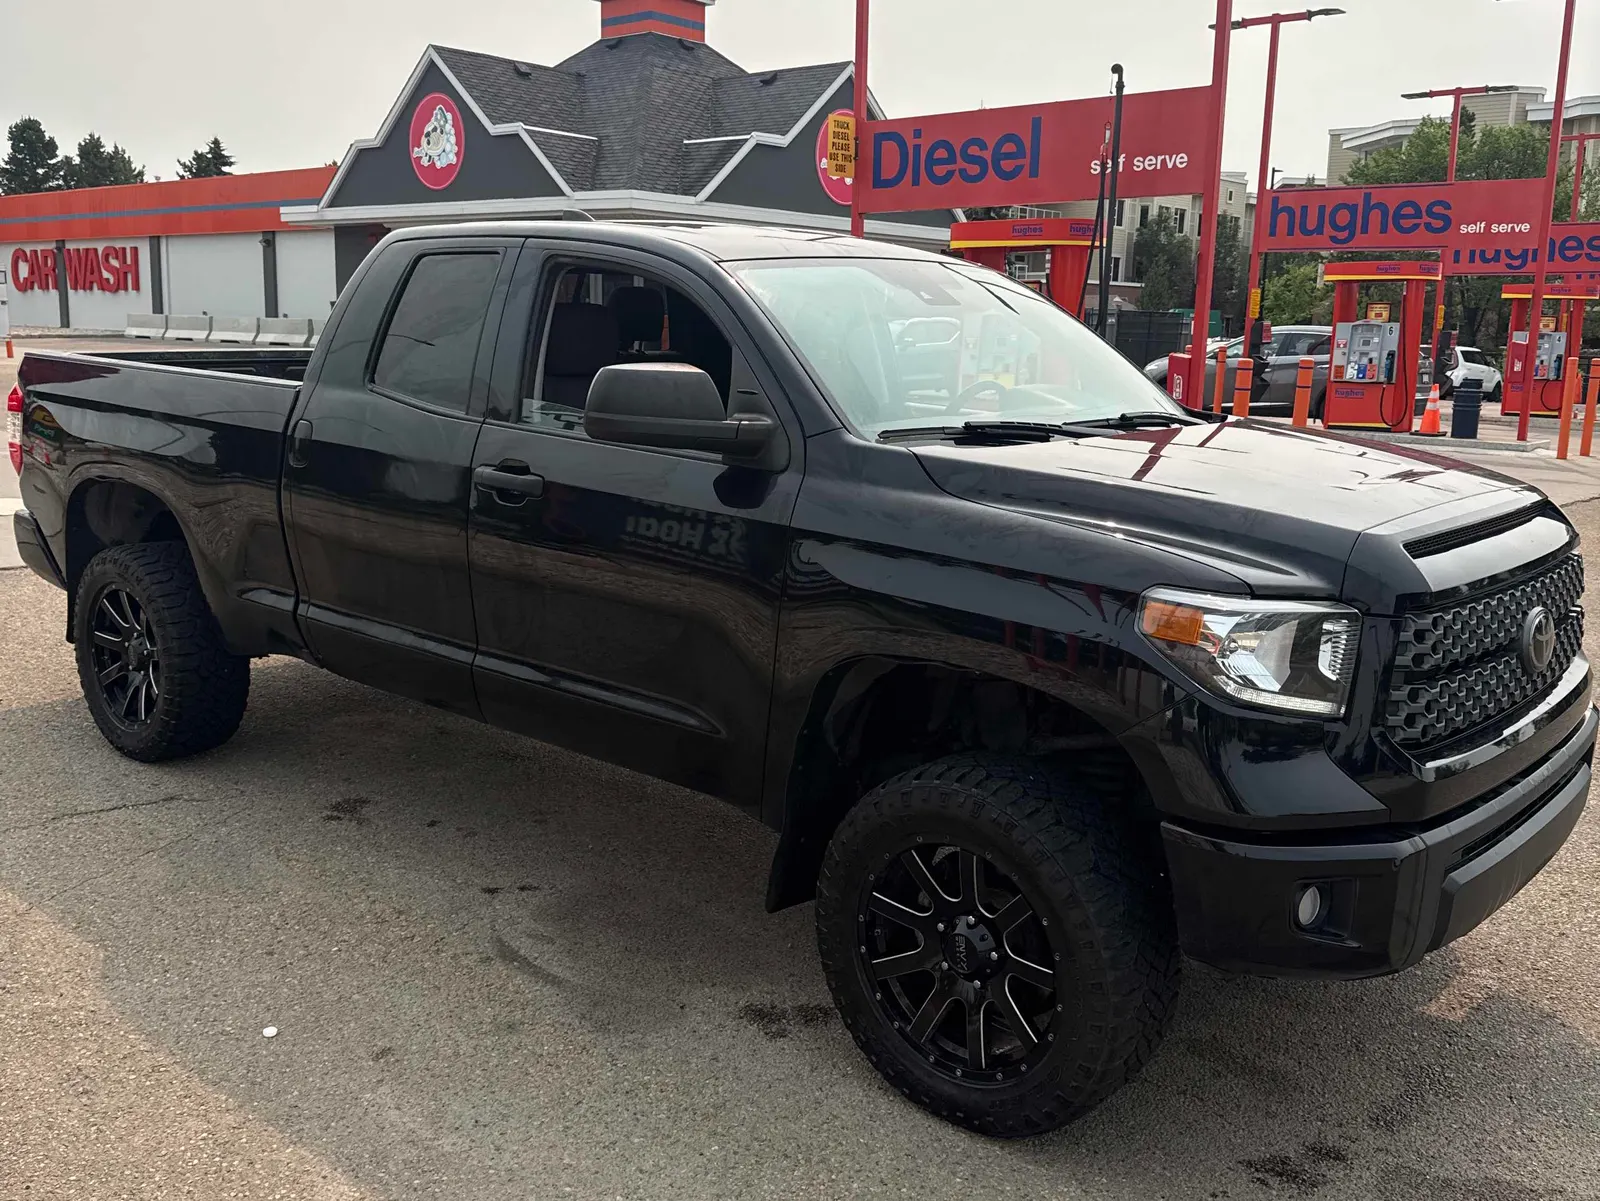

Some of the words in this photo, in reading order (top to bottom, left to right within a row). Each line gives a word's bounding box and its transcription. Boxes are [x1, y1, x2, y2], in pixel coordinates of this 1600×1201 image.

[833, 120, 850, 130] TRUCK
[832, 130, 850, 141] DIESEL
[831, 141, 850, 152] PLEASE
[872, 116, 1042, 189] Diesel
[1090, 154, 1126, 174] sef
[1133, 152, 1188, 171] serve
[1269, 192, 1453, 244] hughes
[1012, 225, 1043, 235] hughes
[1069, 224, 1095, 234] hugh
[1459, 221, 1486, 234] self
[1490, 222, 1531, 233] serve
[11, 247, 59, 292] CAR
[64, 246, 140, 293] WASH
[1388, 326, 1394, 336] 6
